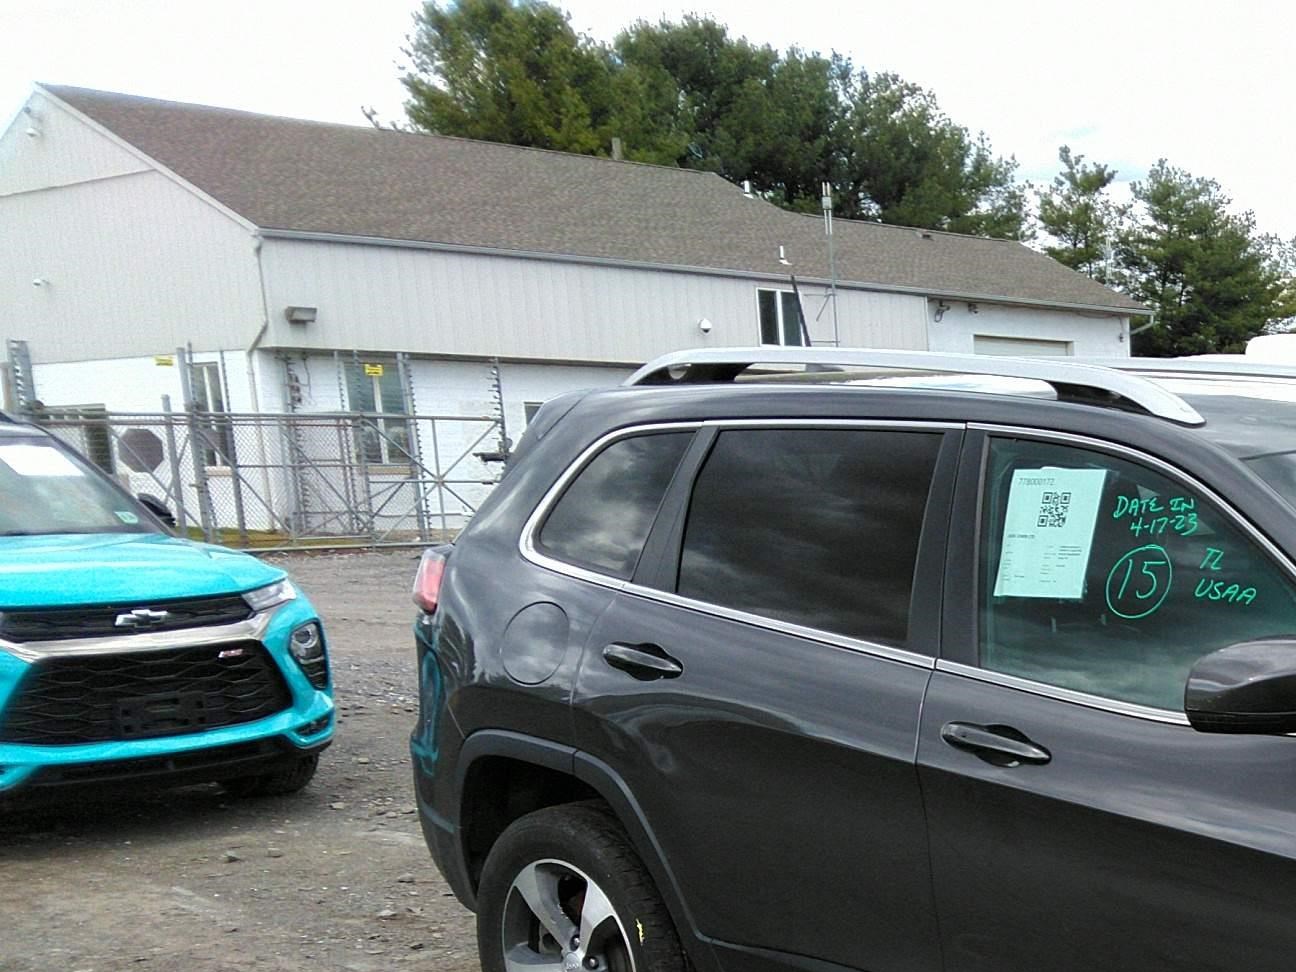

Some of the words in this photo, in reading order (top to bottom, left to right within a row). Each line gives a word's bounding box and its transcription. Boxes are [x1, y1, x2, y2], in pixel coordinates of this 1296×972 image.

[1113, 495, 1165, 518] DATE
[1169, 497, 1195, 513] IN
[1130, 512, 1198, 537] 4-17-23
[1117, 558, 1167, 600] 15
[1194, 578, 1257, 605] USAA
